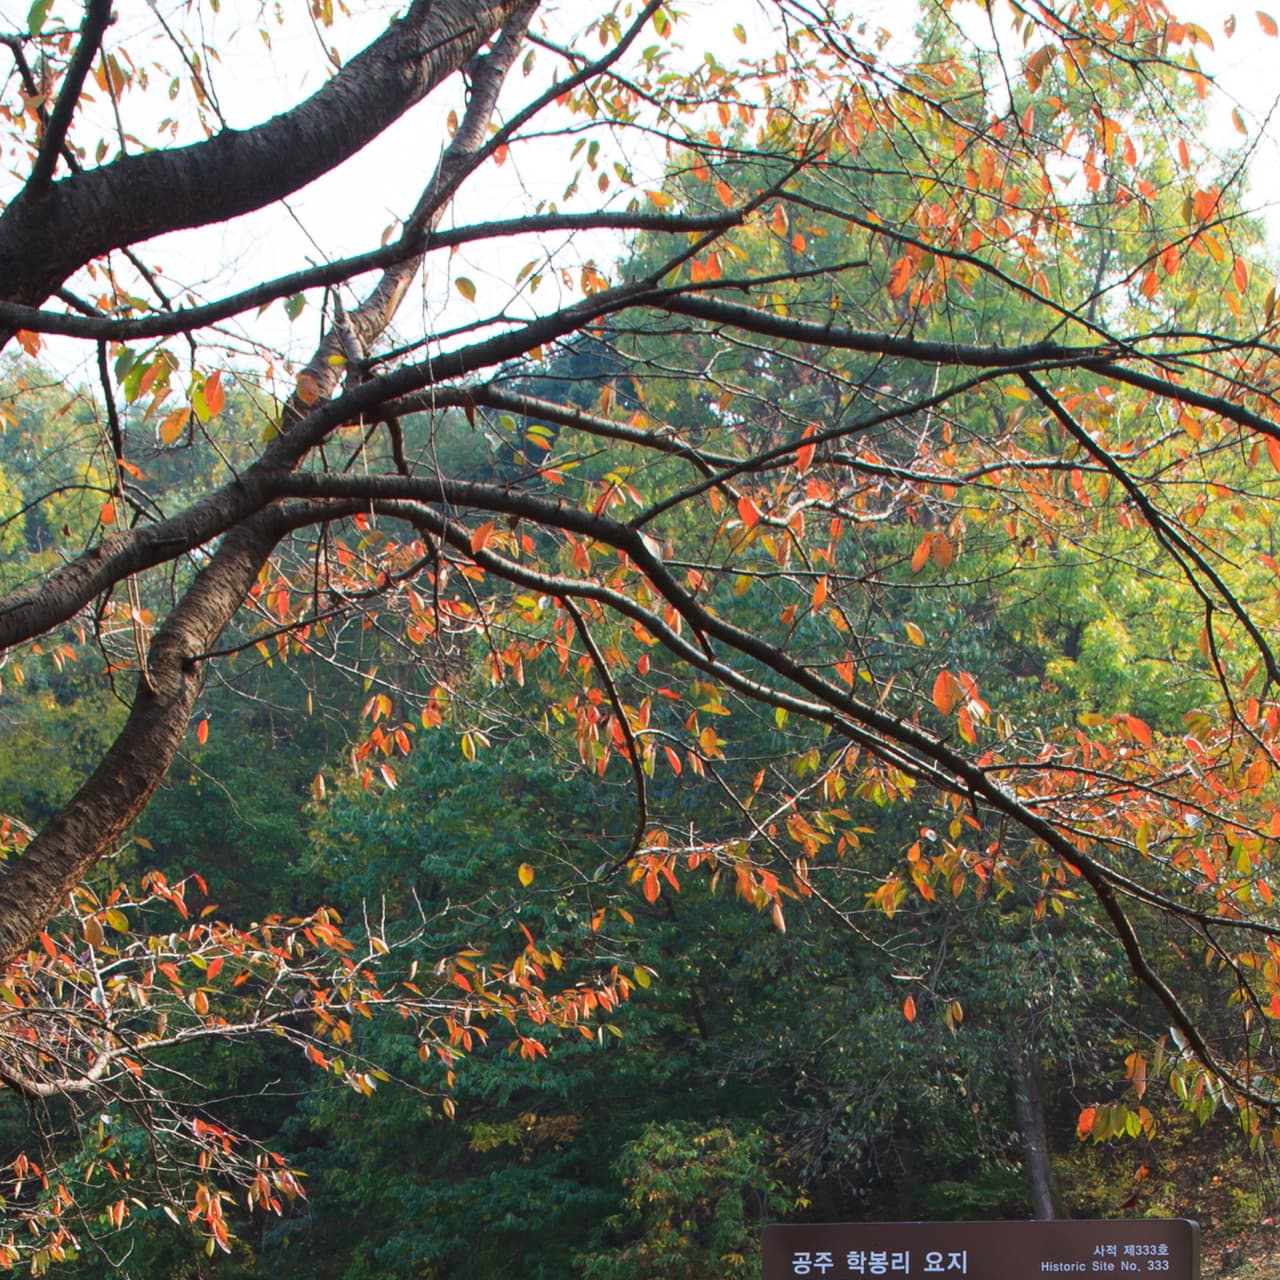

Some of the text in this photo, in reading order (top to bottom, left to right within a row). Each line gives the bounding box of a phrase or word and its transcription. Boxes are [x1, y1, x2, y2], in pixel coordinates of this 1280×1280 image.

[1093, 1244, 1169, 1257] 사적 제333호
[792, 1250, 967, 1274] 공주 학봉리 요지
[1040, 1259, 1169, 1272] Historic Site No. 333
